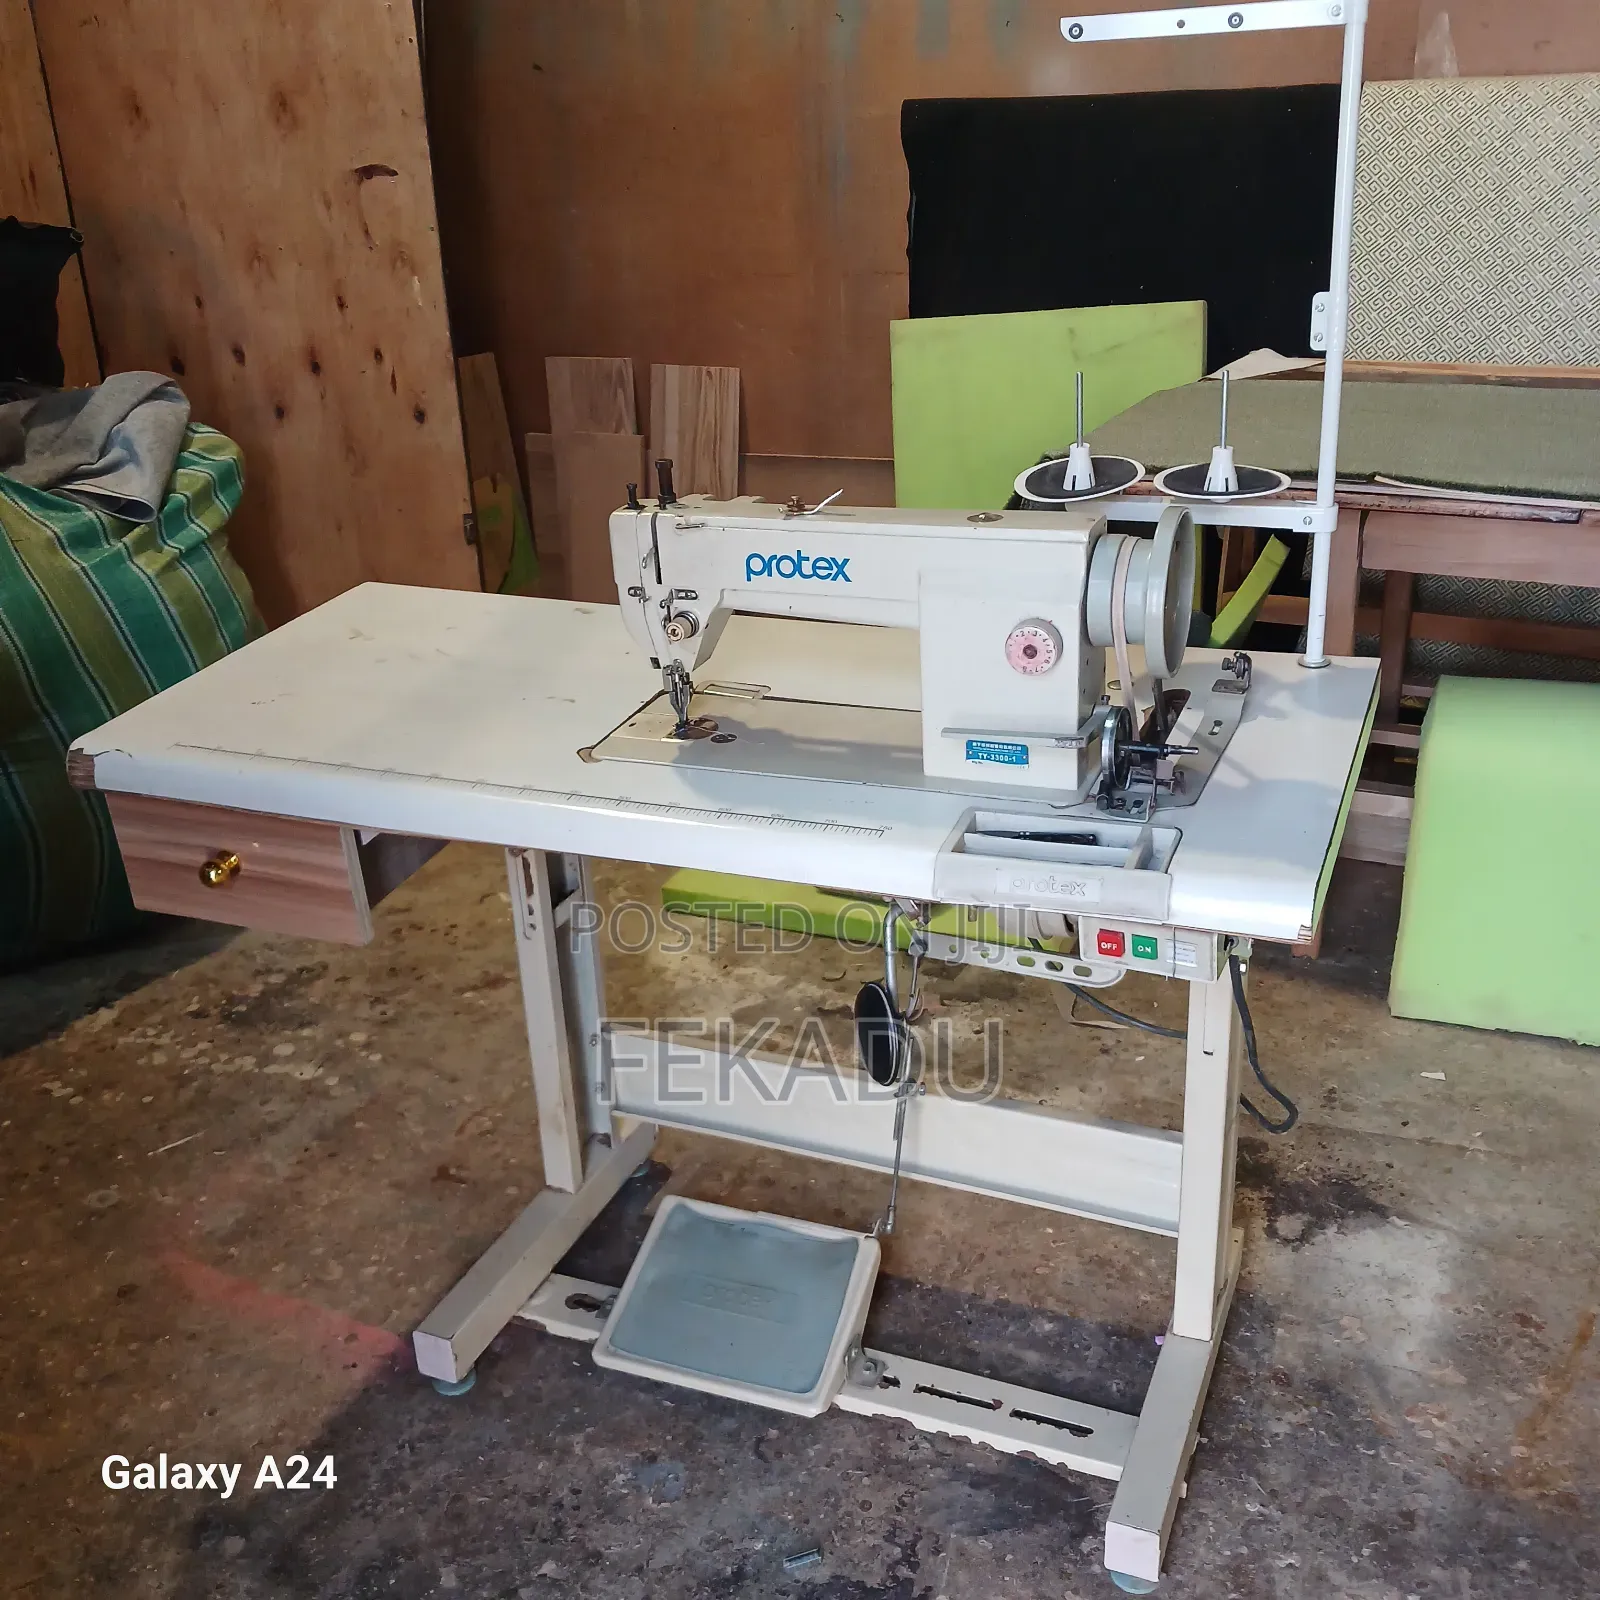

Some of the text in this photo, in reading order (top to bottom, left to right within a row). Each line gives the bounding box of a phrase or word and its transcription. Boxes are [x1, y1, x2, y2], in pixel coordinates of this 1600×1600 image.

[745, 549, 852, 582] protex
[1100, 941, 1118, 951] OFF
[1137, 944, 1152, 954] ON
